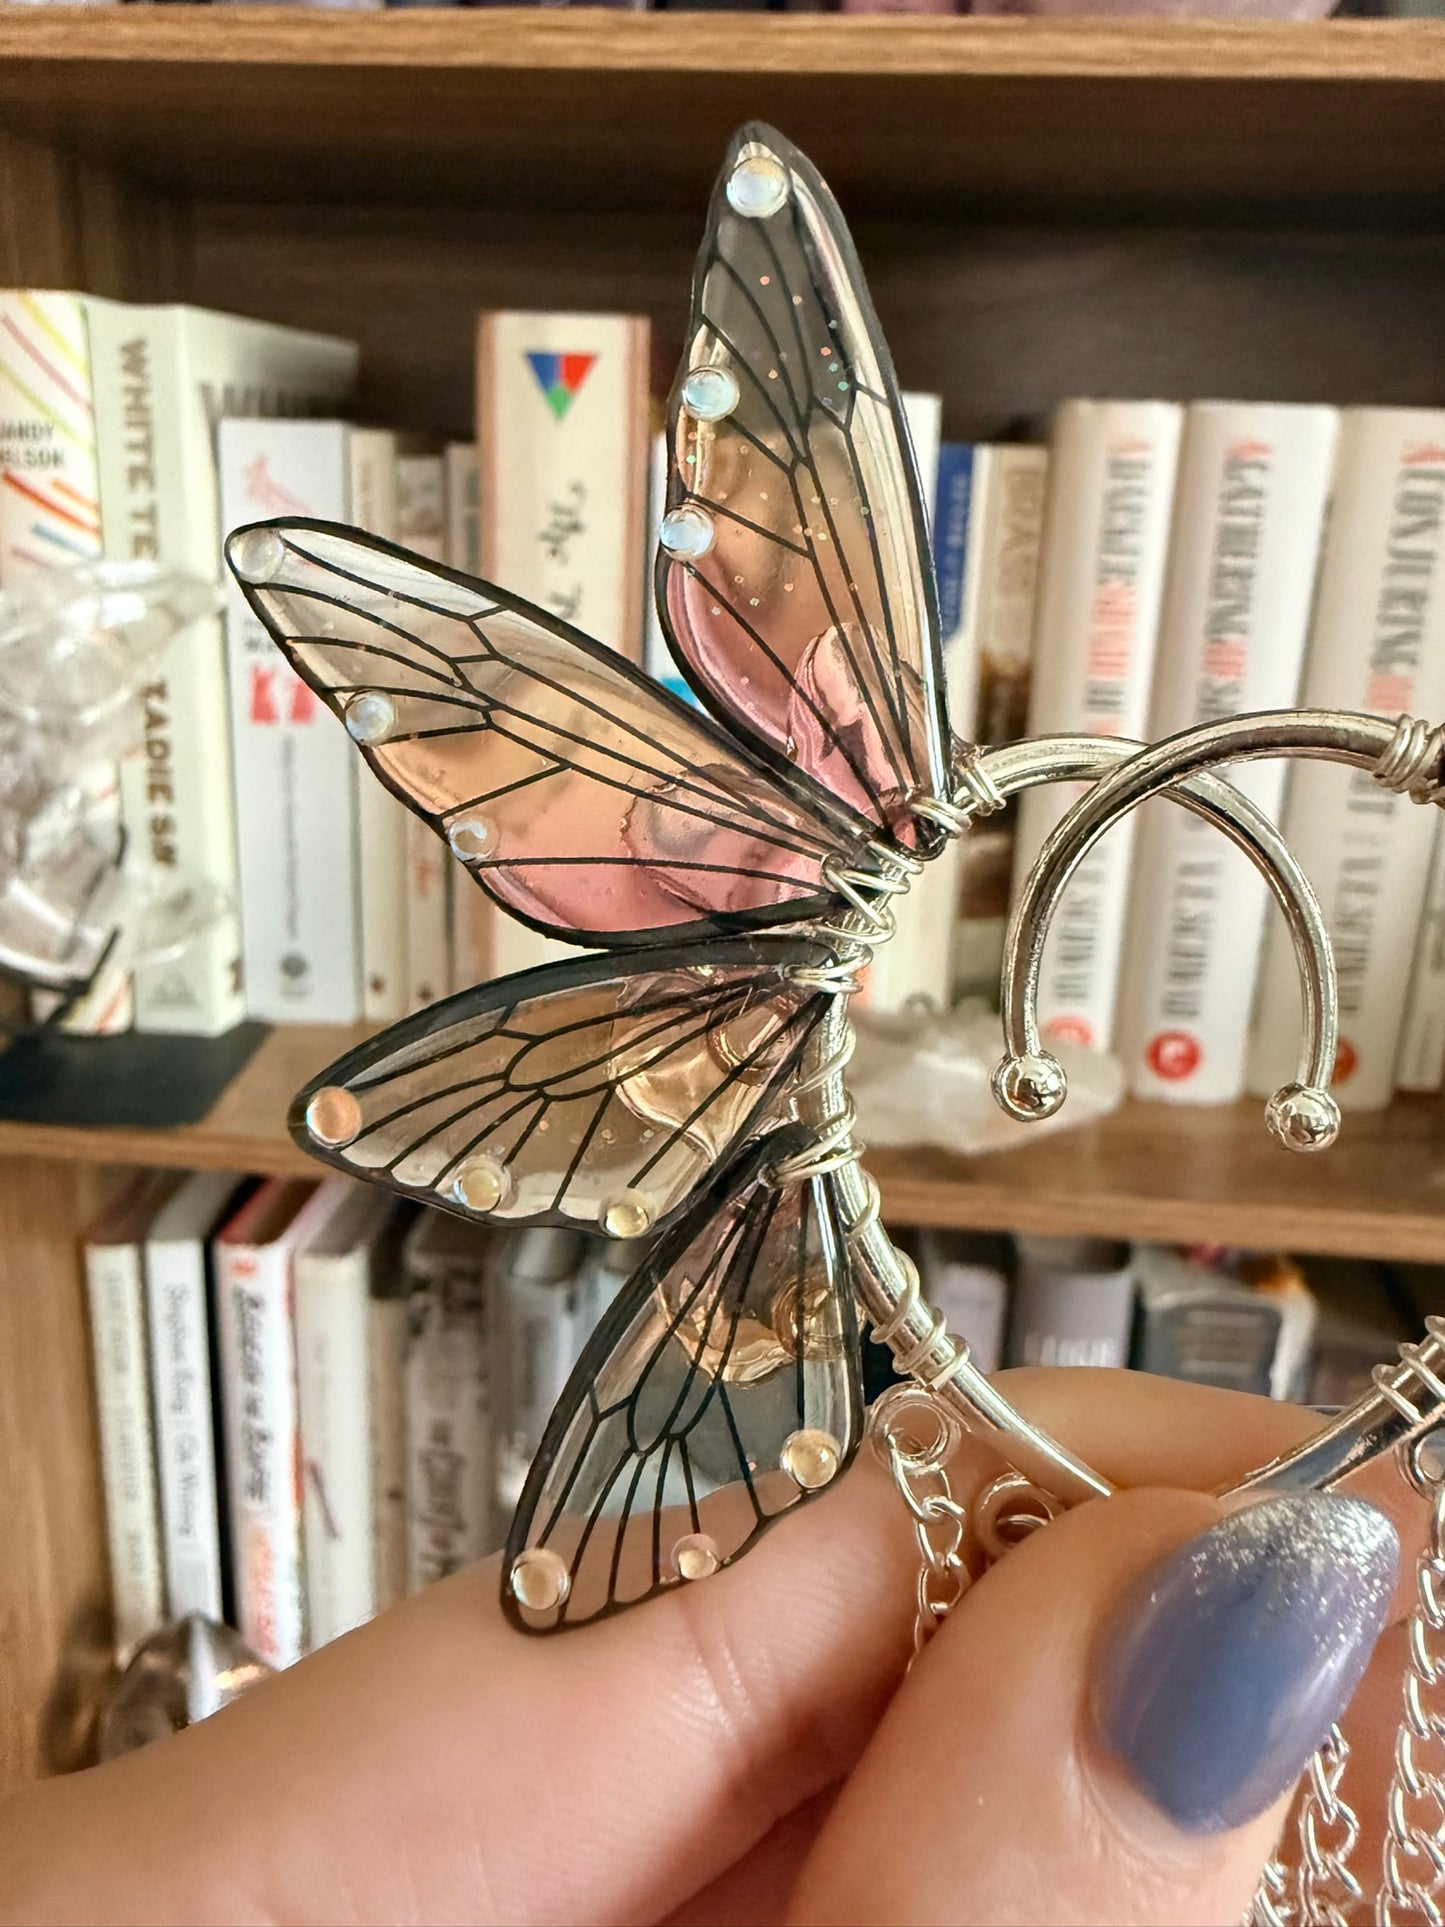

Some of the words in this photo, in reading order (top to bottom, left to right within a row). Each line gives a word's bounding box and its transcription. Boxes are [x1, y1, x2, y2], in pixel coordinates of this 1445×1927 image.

[0, 420, 54, 440] ANDY
[120, 337, 154, 492] WHITE
[130, 502, 160, 561] TE
